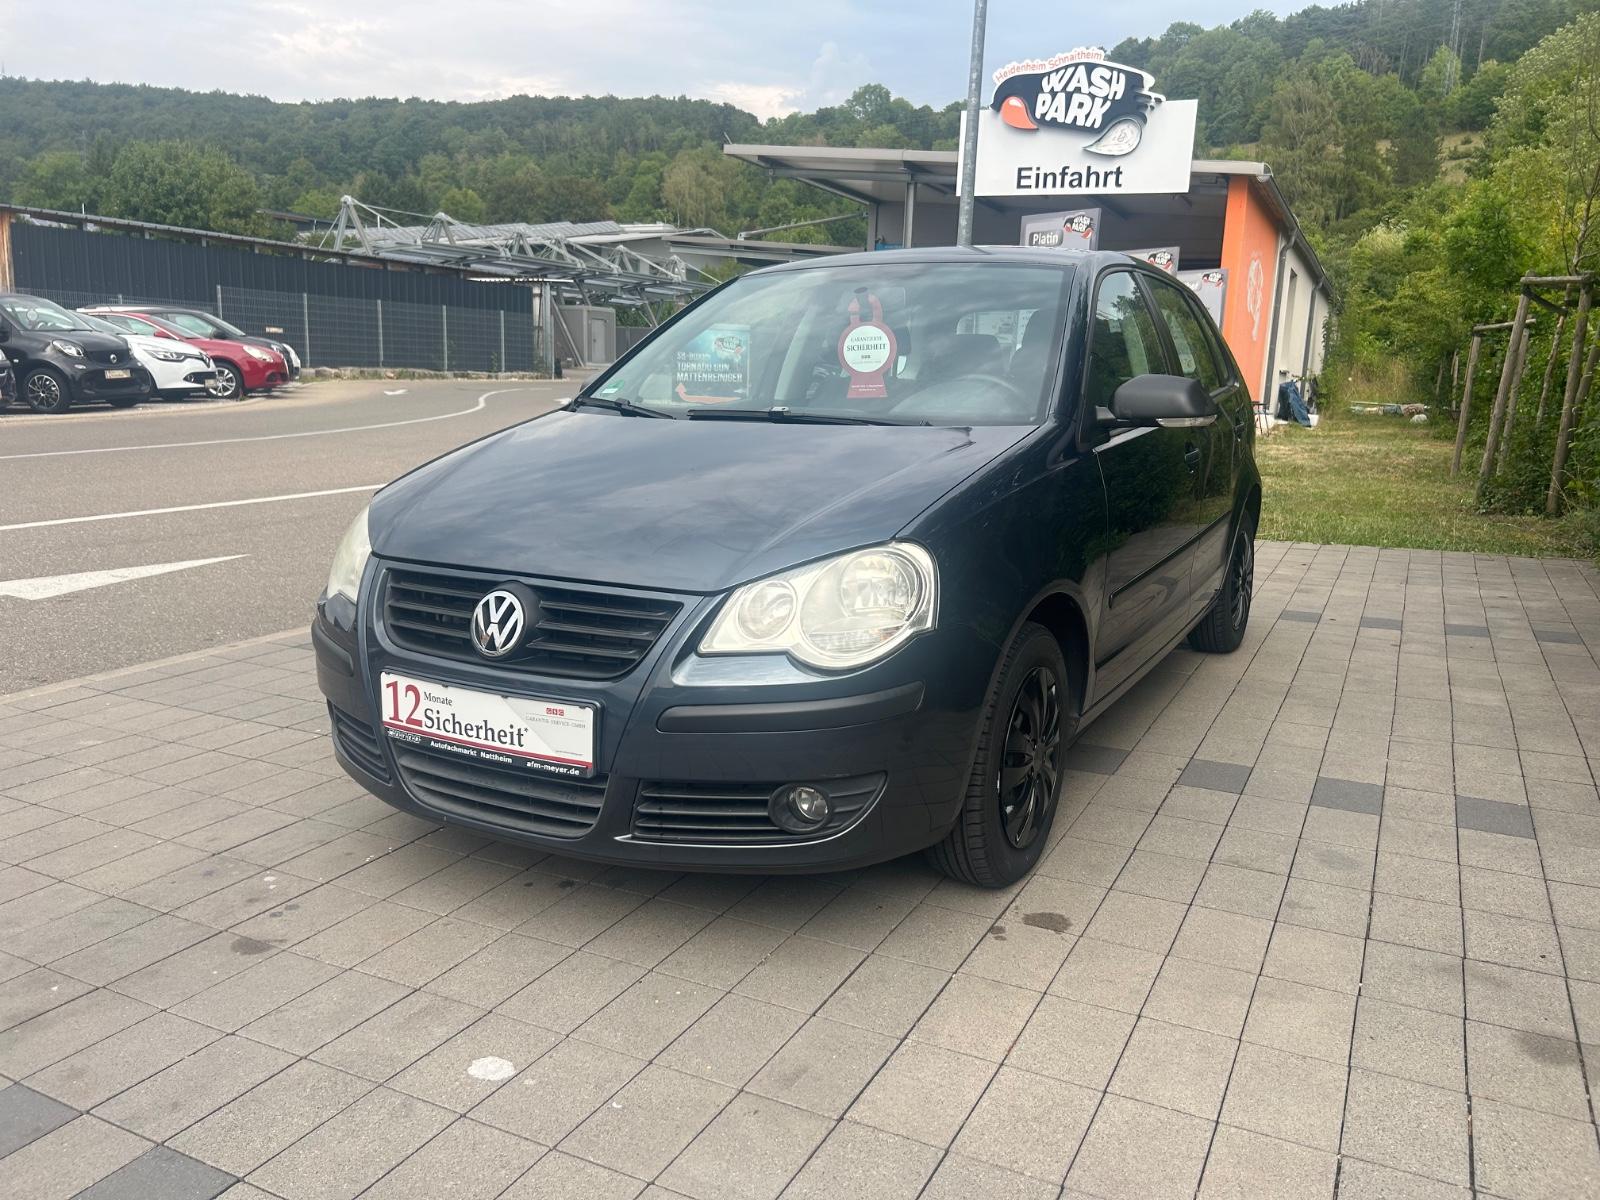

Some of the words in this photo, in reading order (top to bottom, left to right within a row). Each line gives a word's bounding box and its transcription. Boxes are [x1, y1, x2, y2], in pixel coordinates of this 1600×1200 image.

[995, 62, 1047, 83] Heidenheim
[1048, 50, 1103, 68] Schnaitheim
[1041, 65, 1126, 100] WASH
[1034, 92, 1112, 129] PARK
[1016, 166, 1123, 190] Einfahrt
[1032, 232, 1059, 246] Platin
[846, 343, 886, 352] SICHERHEIT
[676, 372, 743, 383] MATTENREINIGER
[386, 681, 423, 728] 12
[424, 691, 453, 706] Monate
[430, 740, 477, 757] Autofachmarkt
[480, 751, 513, 764] Nattheim
[526, 761, 580, 776] afm-meyer.de
